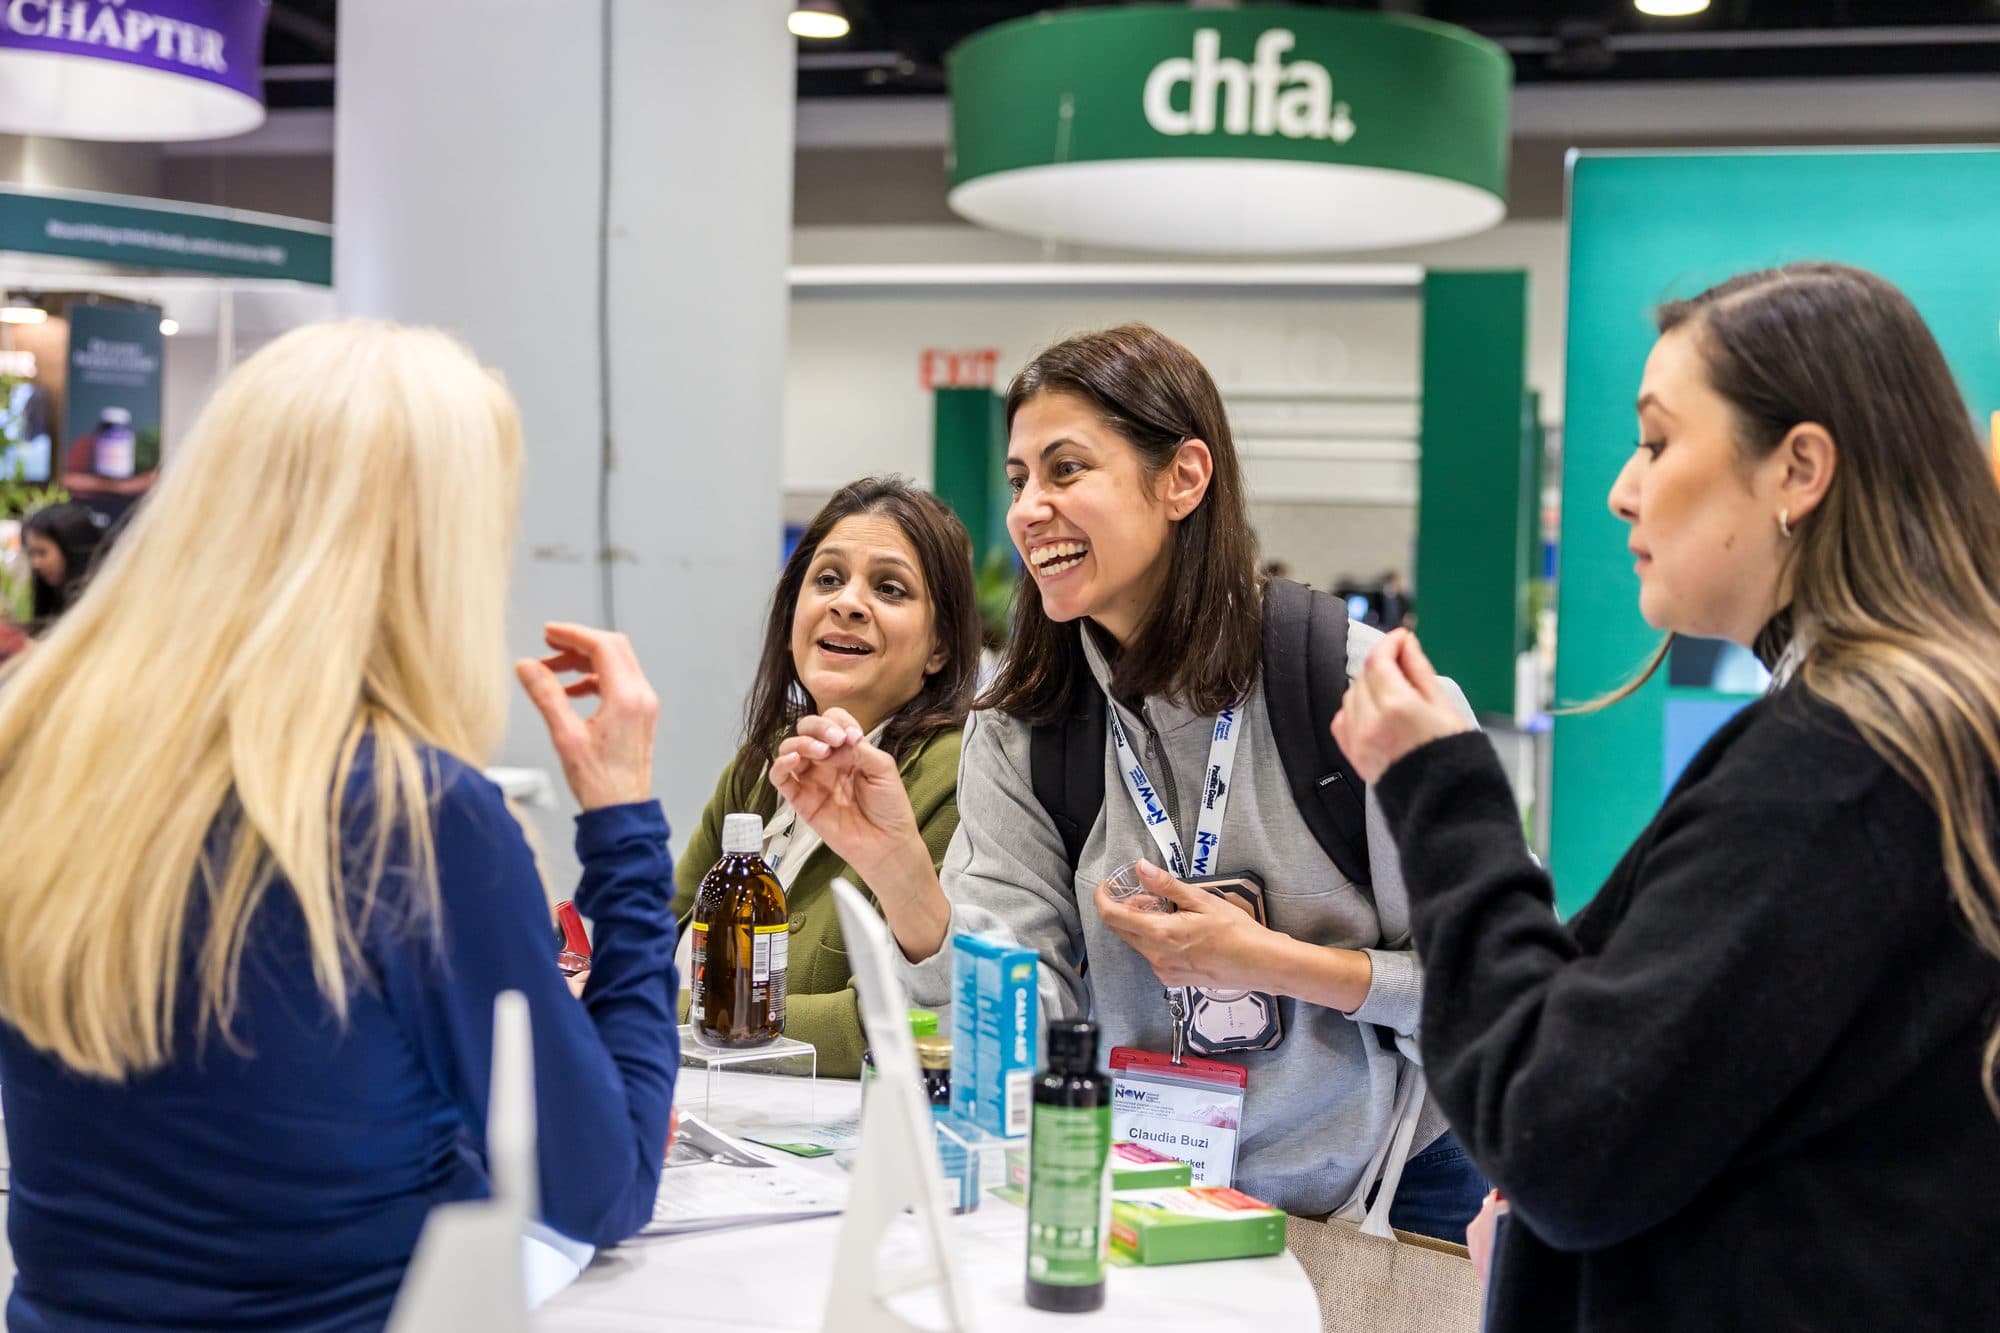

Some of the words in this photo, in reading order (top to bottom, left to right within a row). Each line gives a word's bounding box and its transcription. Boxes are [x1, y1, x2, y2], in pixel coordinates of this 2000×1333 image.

[7, 0, 228, 74] CHAPTER
[919, 349, 1003, 388] EXIT
[1210, 765, 1221, 789] Pacific
[1138, 787, 1167, 824] NOW
[1206, 789, 1217, 810] Coast
[1193, 831, 1211, 874] NOW
[1115, 1088, 1146, 1101] NOW
[1129, 1127, 1177, 1144] Claudia
[1181, 1134, 1209, 1149] Buzi
